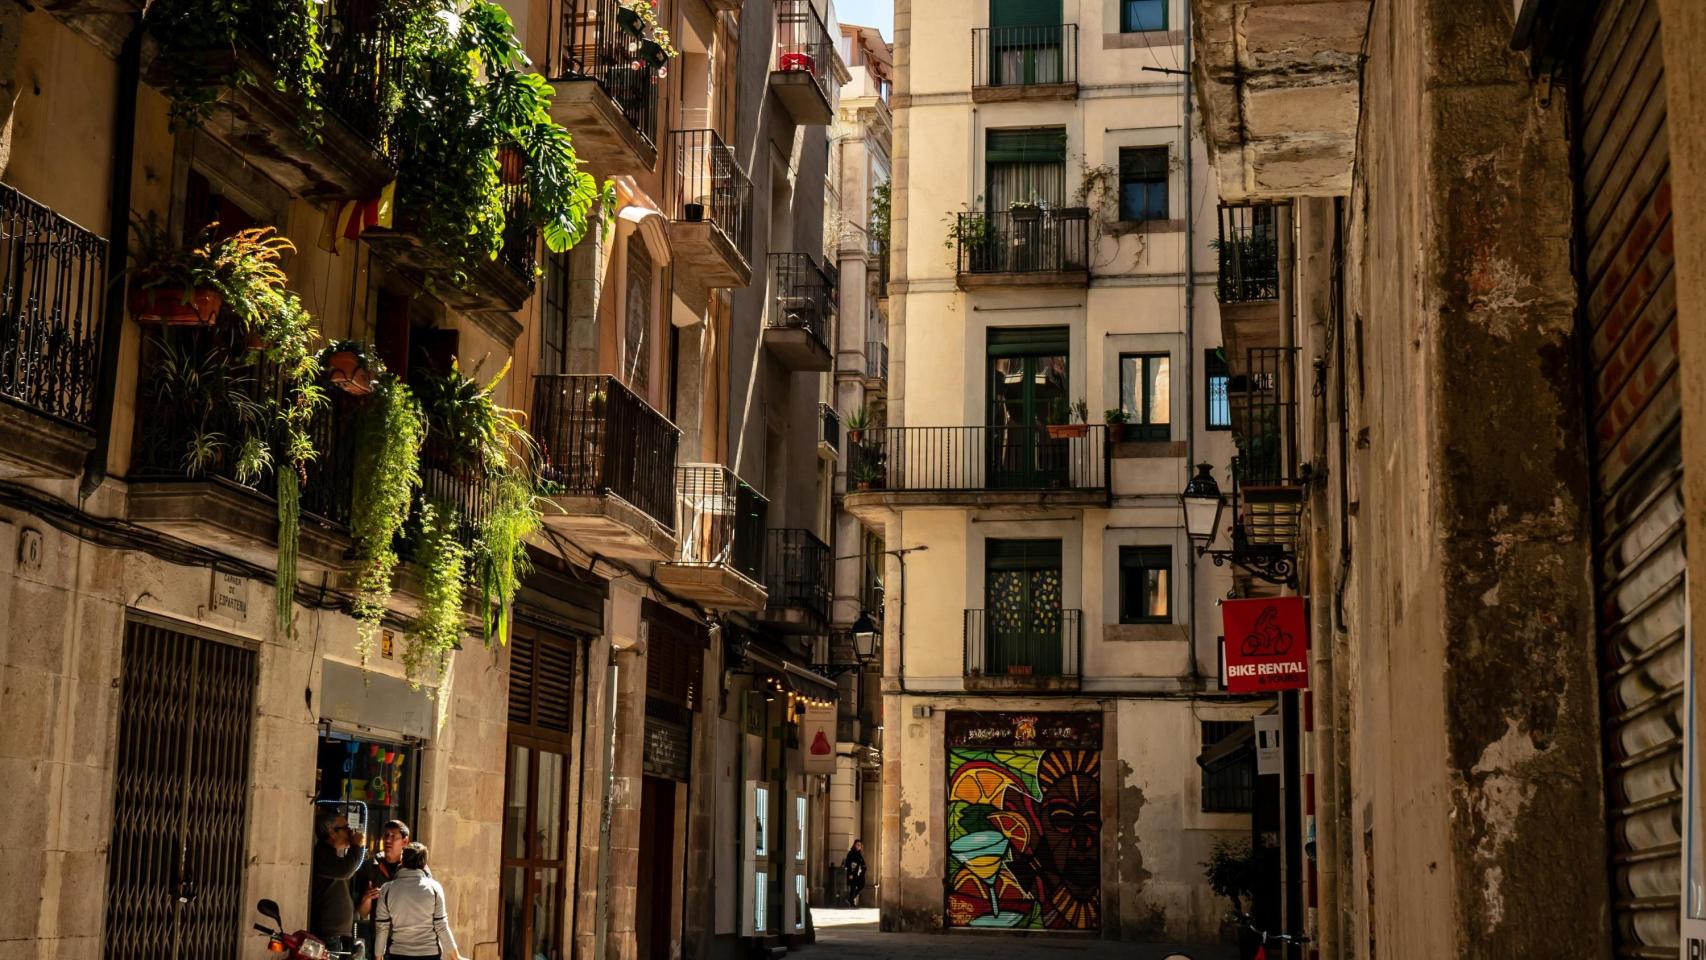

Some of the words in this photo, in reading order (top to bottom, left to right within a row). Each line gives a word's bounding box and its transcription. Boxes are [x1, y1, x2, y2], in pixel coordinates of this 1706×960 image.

[30, 539, 37, 561] 6
[1228, 664, 1256, 677] BIKE
[1257, 662, 1306, 675] RENTAL
